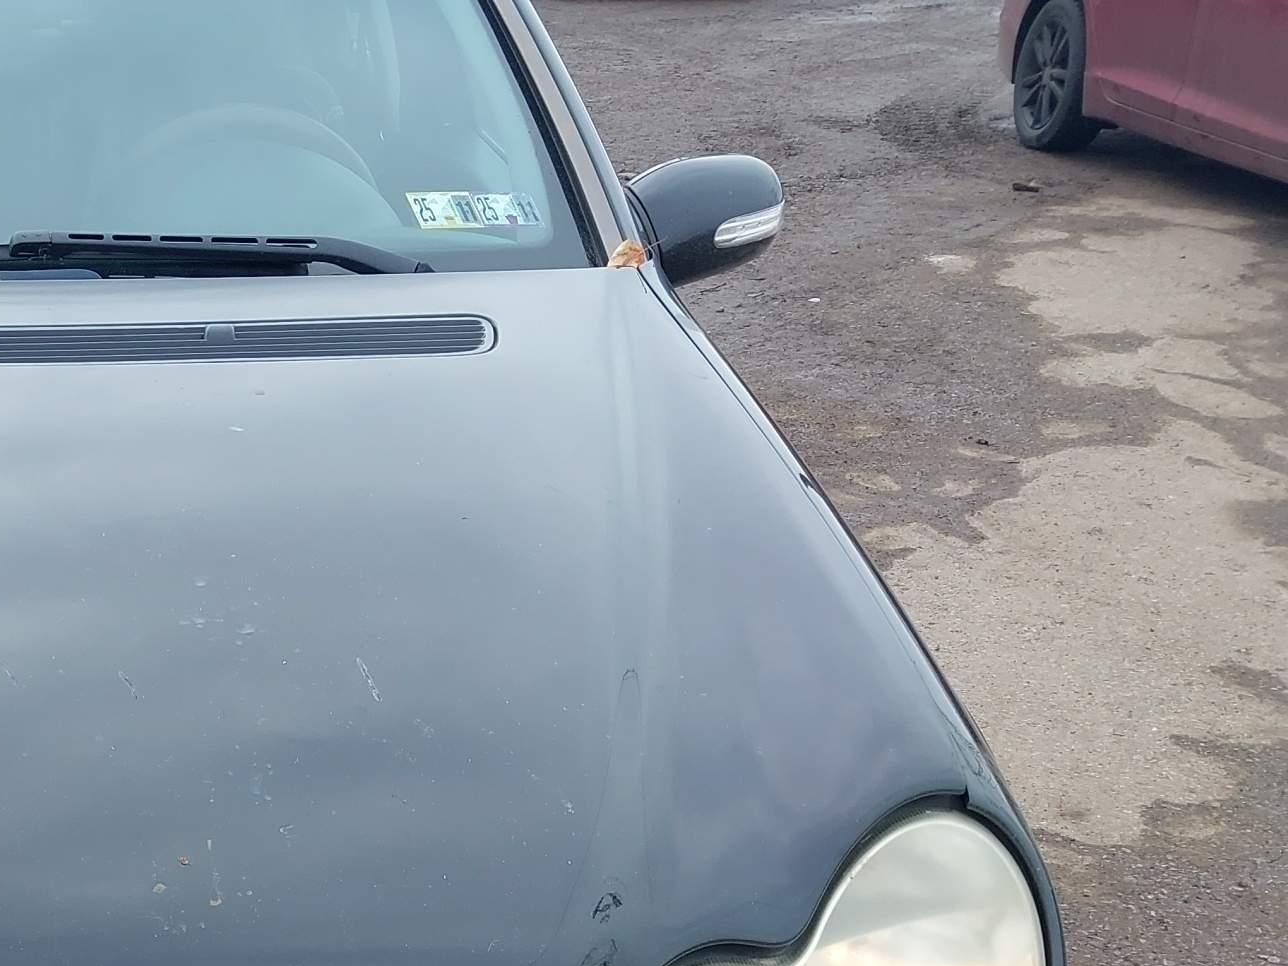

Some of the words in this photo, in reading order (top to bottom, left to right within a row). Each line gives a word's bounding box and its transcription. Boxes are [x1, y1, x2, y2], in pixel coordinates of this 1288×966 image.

[414, 198, 436, 222] 25
[455, 201, 478, 222] 11
[476, 197, 499, 223] 25
